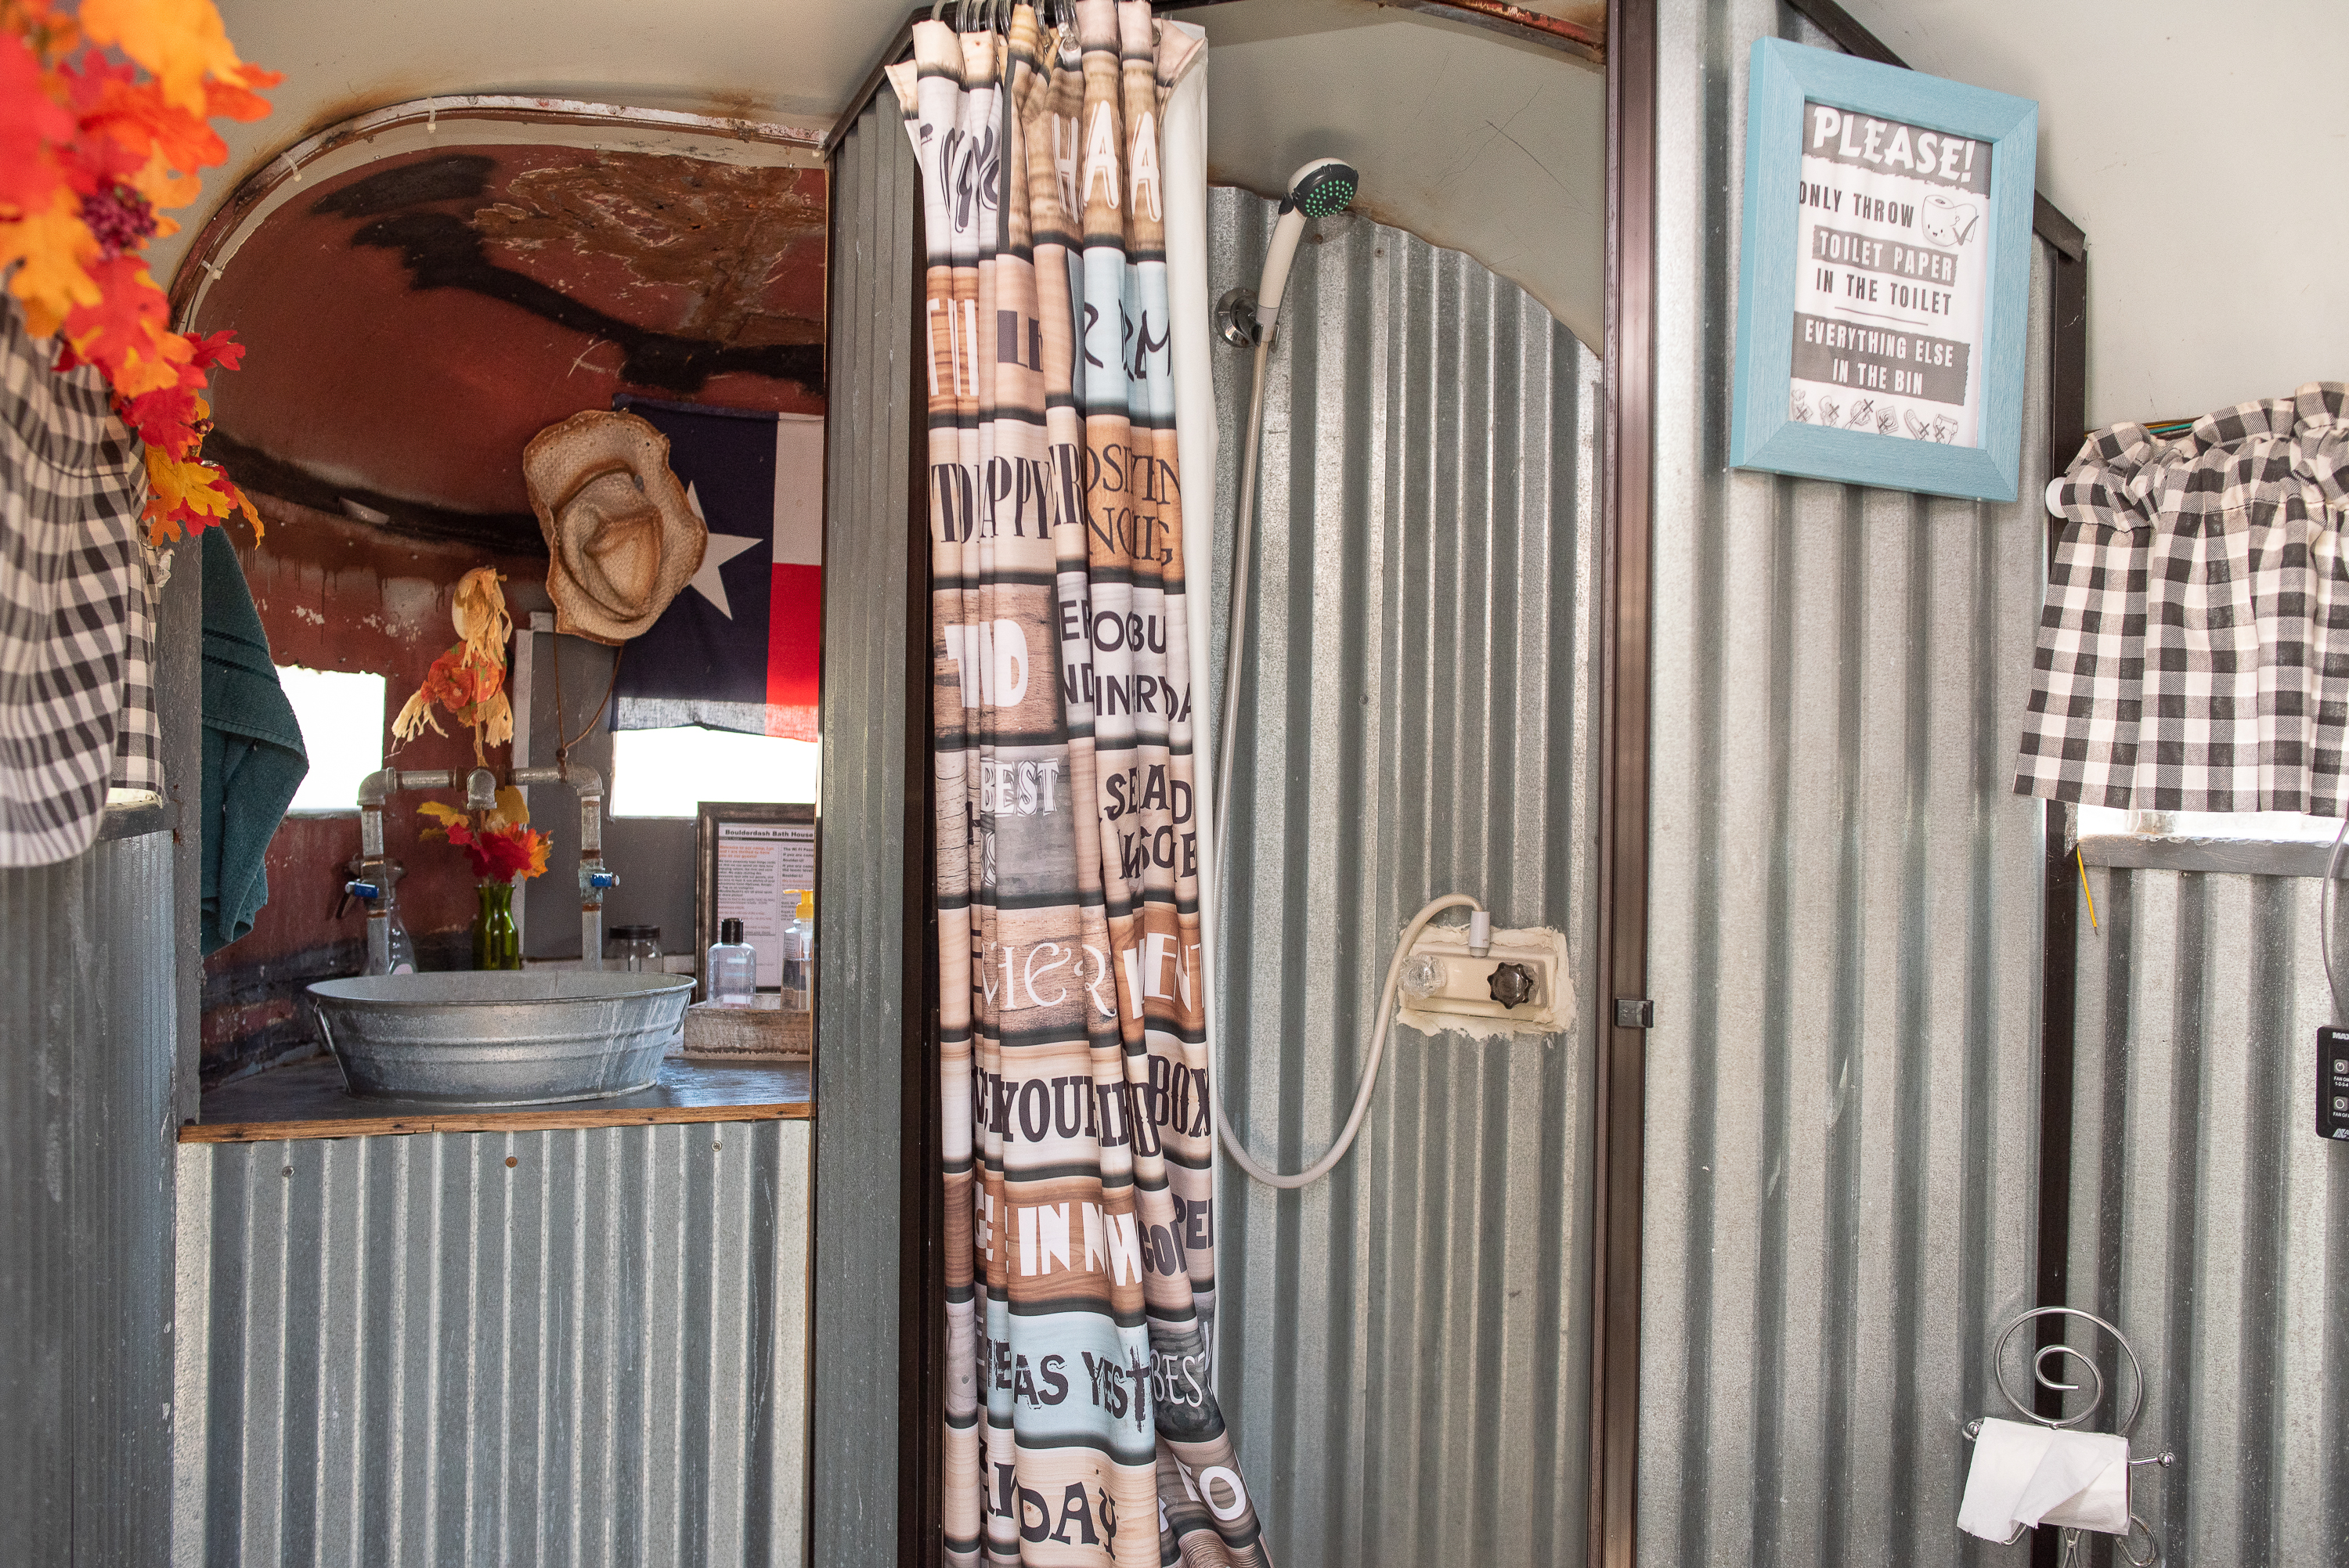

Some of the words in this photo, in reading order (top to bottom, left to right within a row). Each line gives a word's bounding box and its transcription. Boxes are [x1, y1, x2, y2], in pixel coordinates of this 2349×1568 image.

[1813, 106, 1976, 183] PLEASE!
[1799, 180, 1842, 213] ONLY
[1853, 192, 1914, 229] THROW
[1820, 230, 1883, 268] TOILET
[1893, 246, 1953, 282] PAPER
[1816, 267, 1834, 294] IN
[1846, 273, 1878, 302] THE
[1890, 282, 1952, 315] TOILET
[1805, 319, 1907, 360] EVERYTHING
[1915, 339, 1954, 367] ELSE
[1832, 358, 1849, 384] IN
[1857, 362, 1888, 390] THE
[1894, 369, 1924, 395] BIN
[980, 758, 1059, 818] BEST
